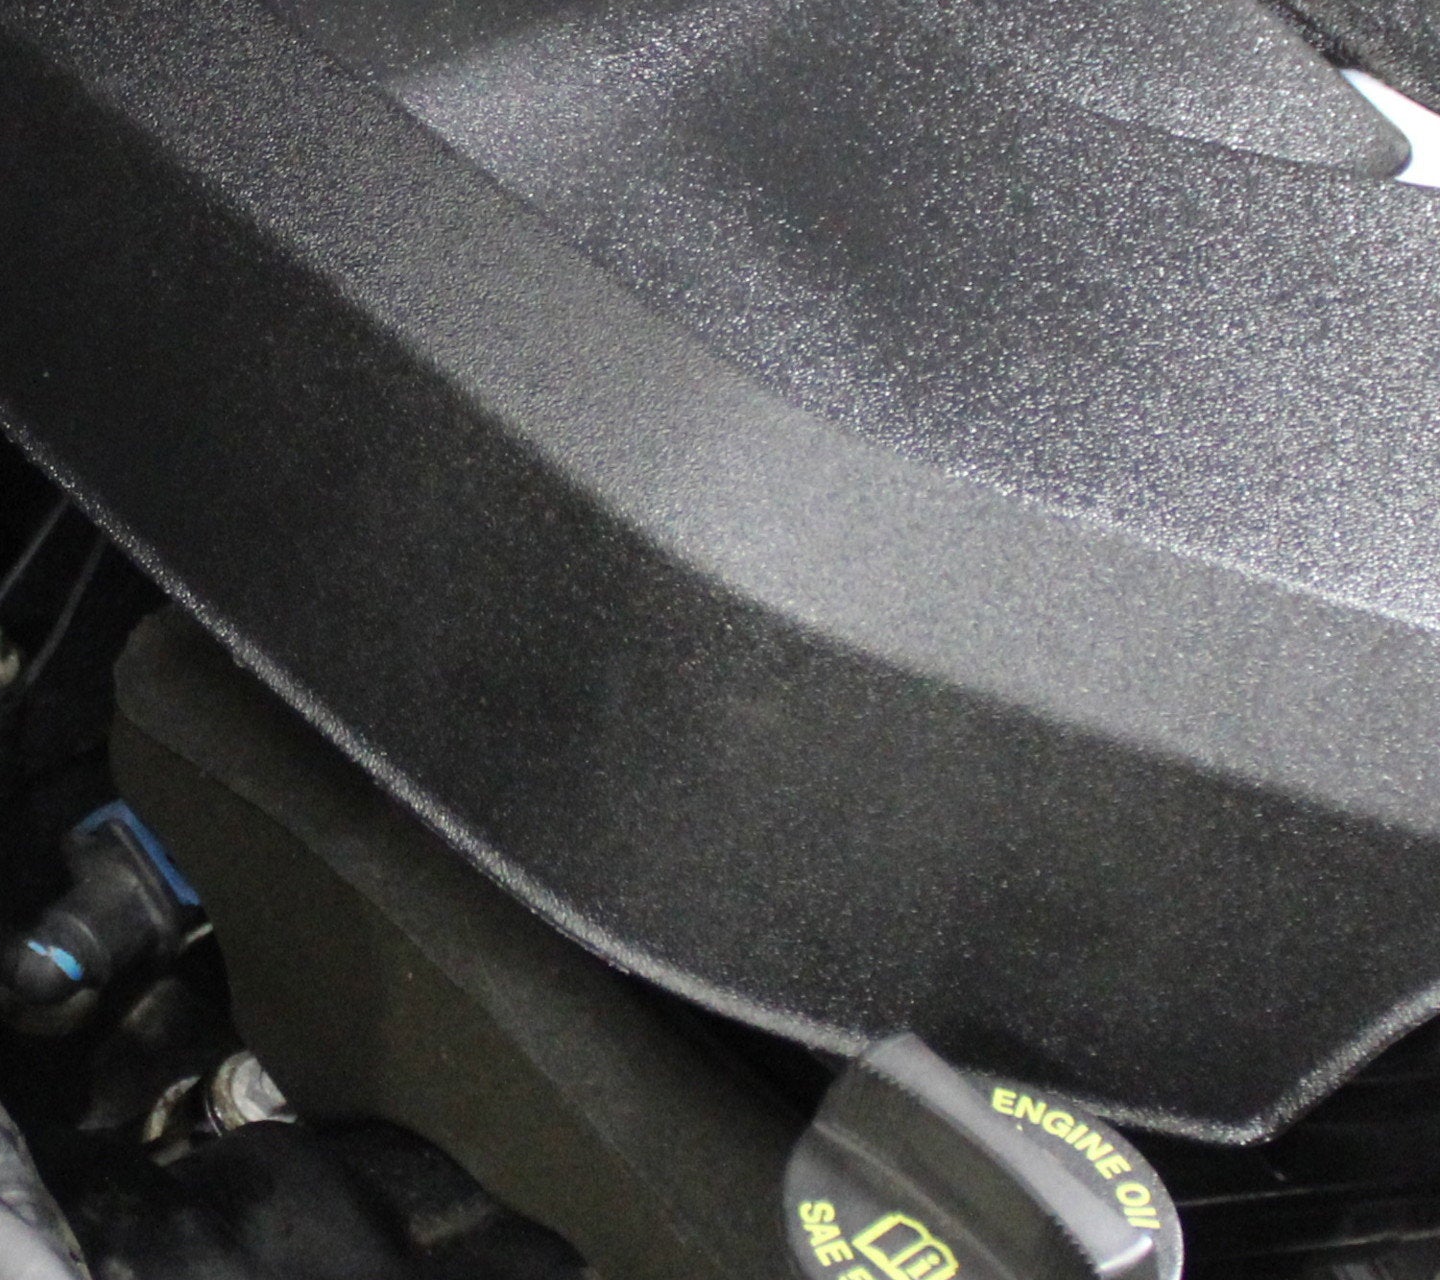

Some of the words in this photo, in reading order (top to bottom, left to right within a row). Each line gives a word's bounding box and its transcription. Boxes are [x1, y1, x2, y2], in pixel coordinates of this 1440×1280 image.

[992, 1087, 1132, 1180] ENGINE
[1115, 1182, 1162, 1230] OIL
[799, 1199, 854, 1267] SAE
